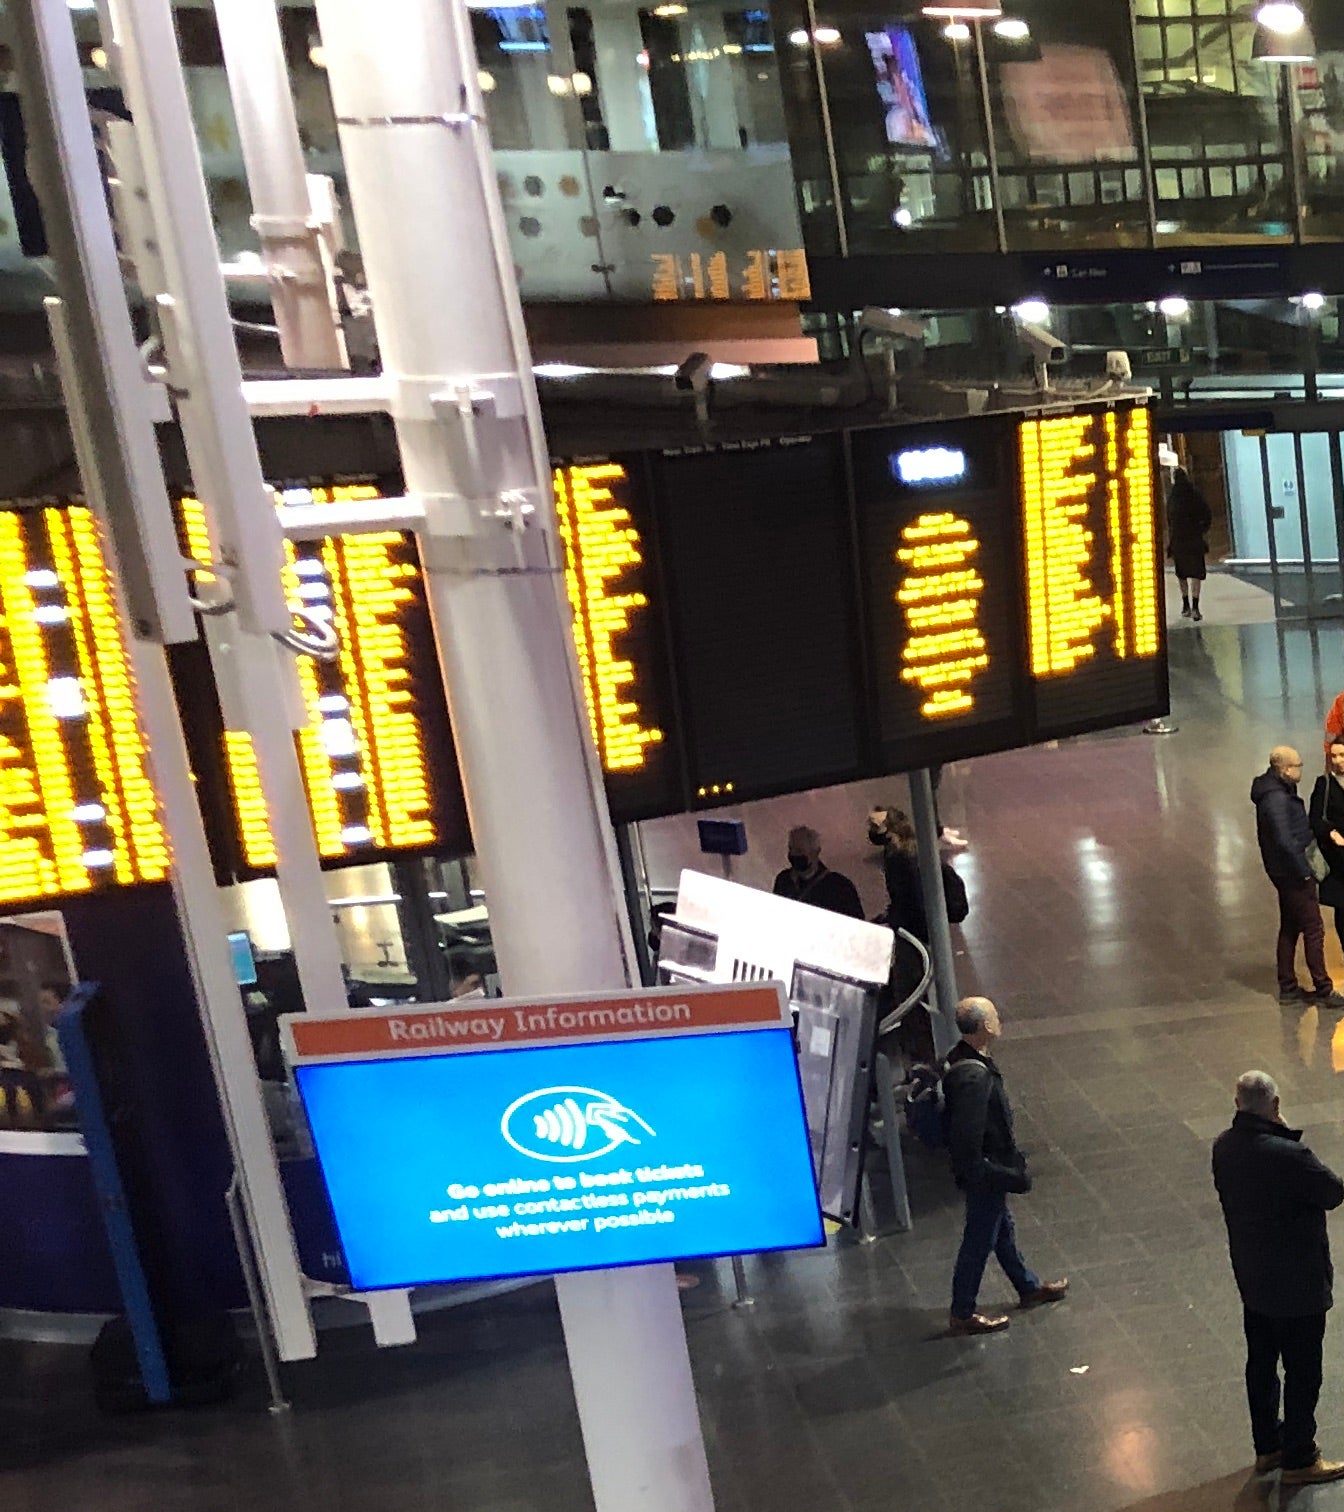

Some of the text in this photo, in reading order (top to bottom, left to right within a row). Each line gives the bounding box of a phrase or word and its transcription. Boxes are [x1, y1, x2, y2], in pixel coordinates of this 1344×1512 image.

[387, 1001, 691, 1042] Railway Information
[447, 1164, 704, 1200] Go online to book tickets
[429, 1183, 730, 1223] and use contactless payments
[496, 1208, 675, 1239] wherever possible
